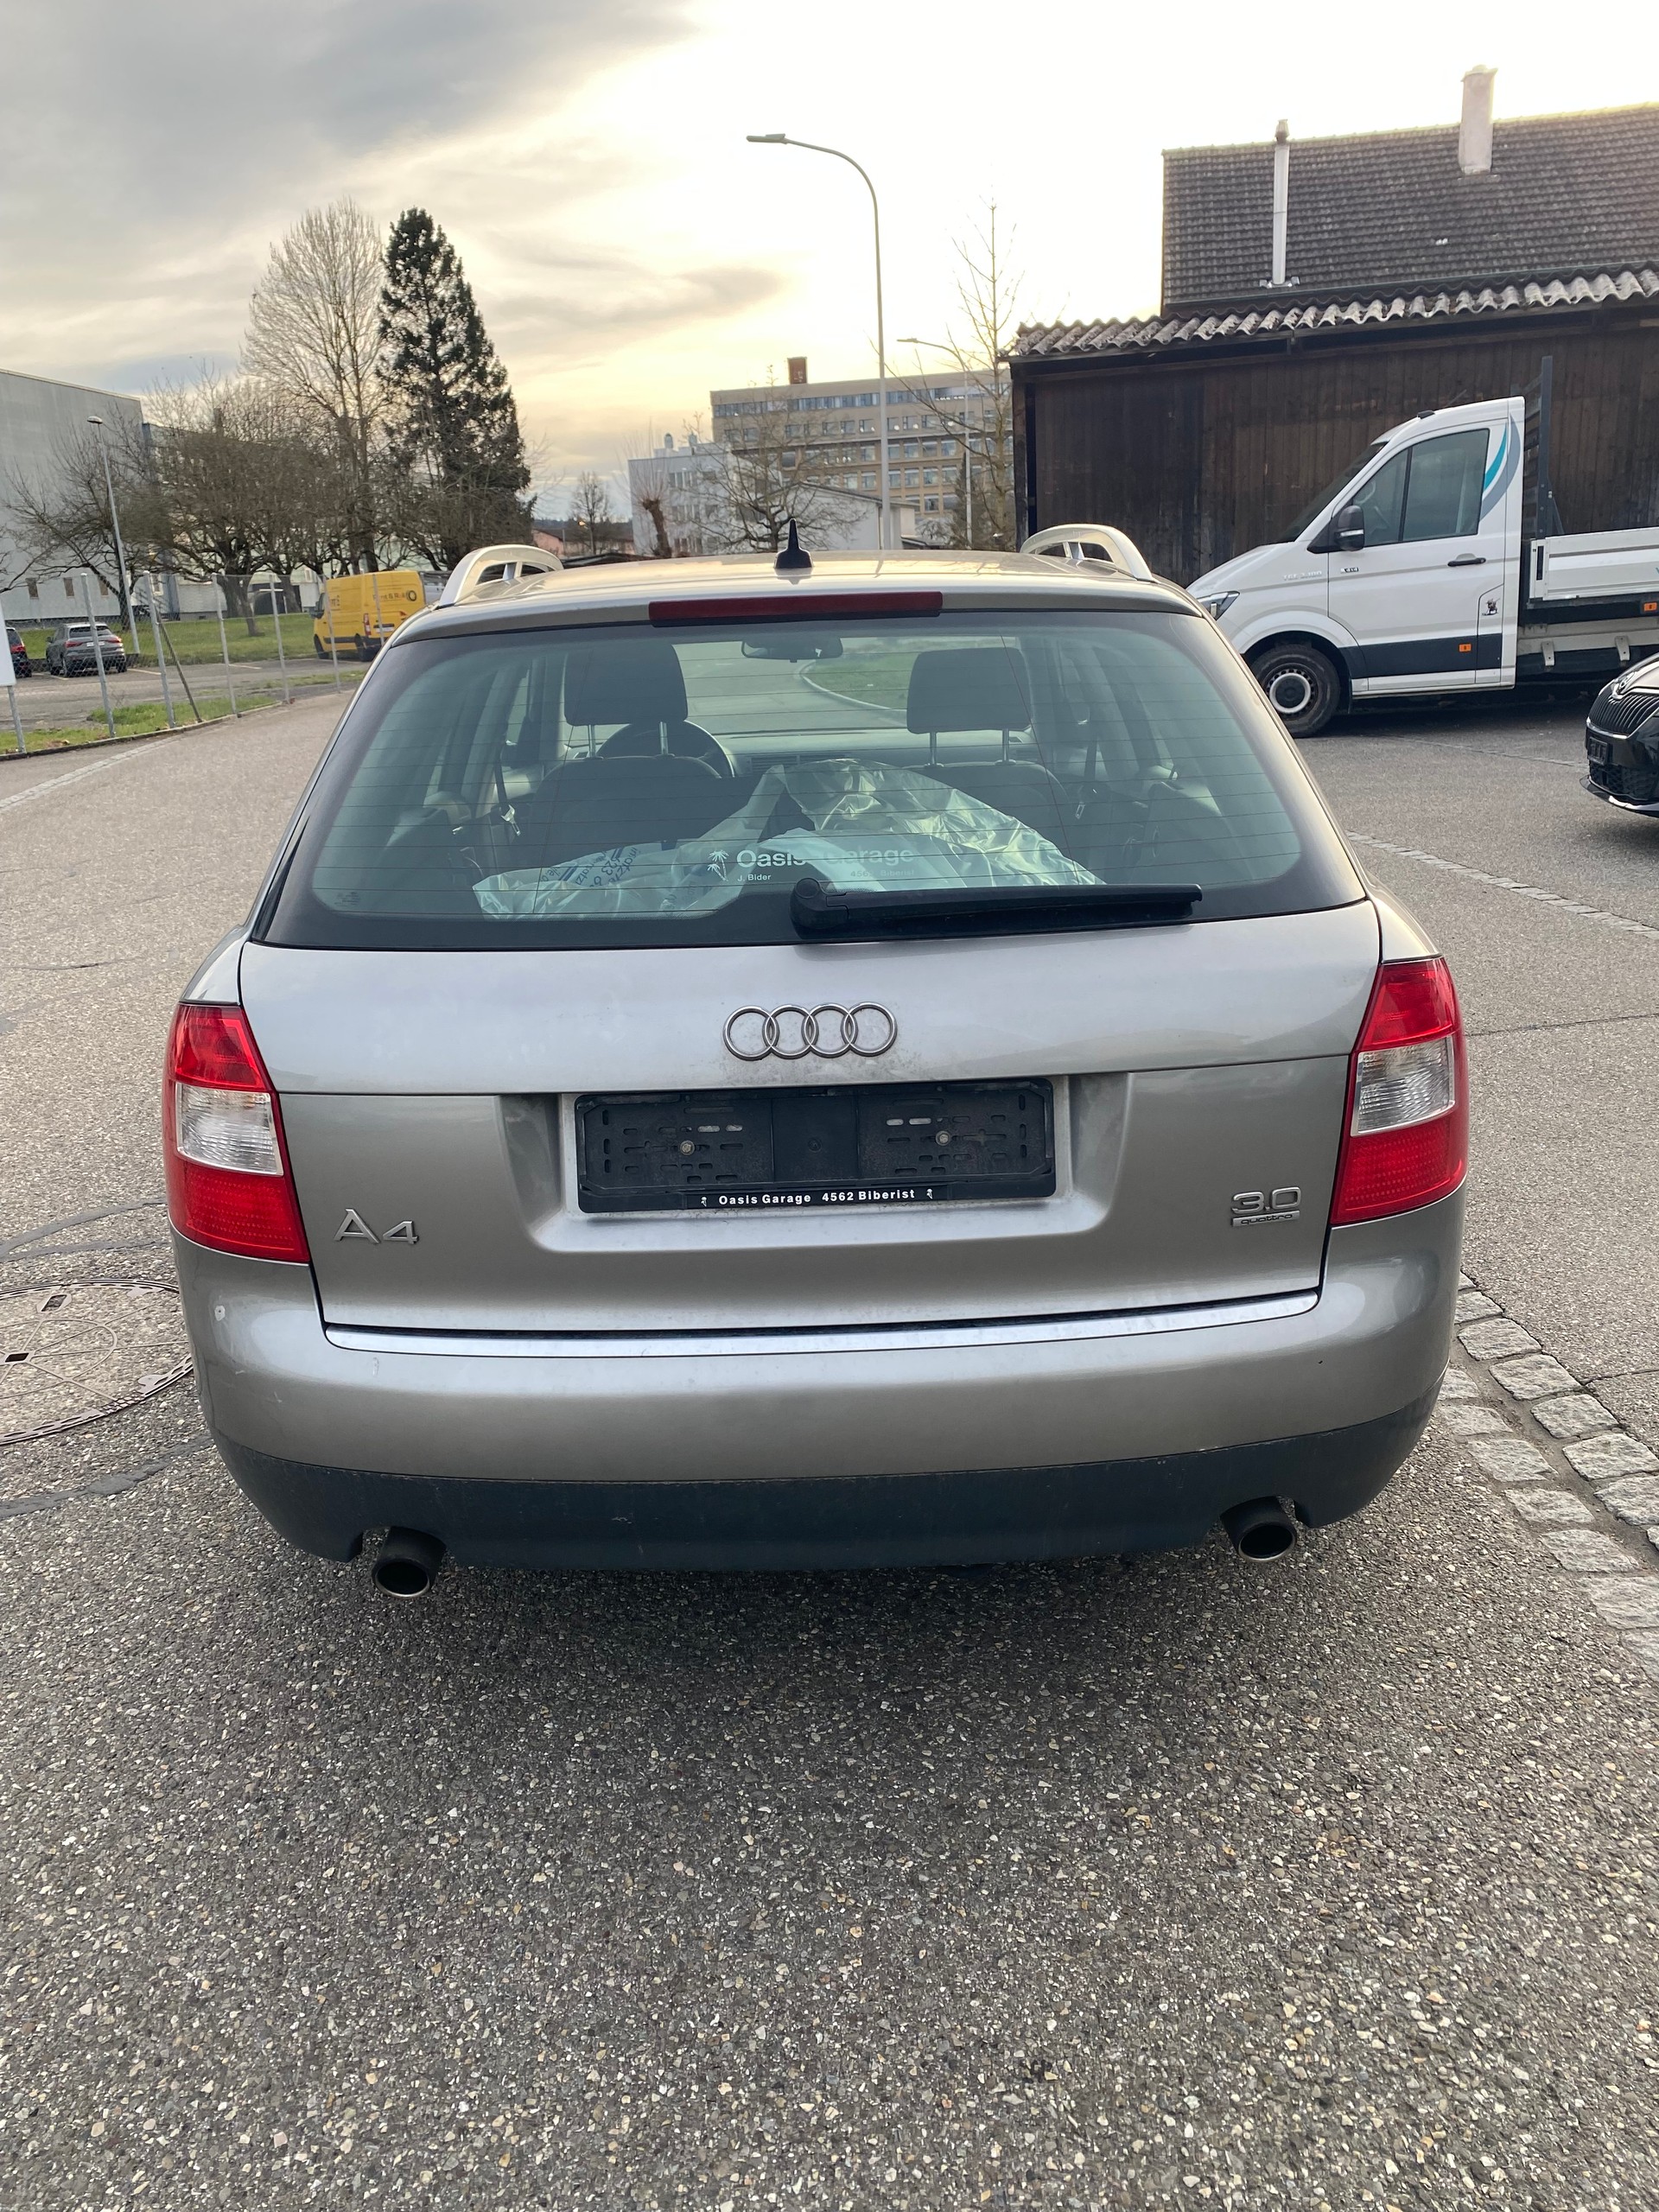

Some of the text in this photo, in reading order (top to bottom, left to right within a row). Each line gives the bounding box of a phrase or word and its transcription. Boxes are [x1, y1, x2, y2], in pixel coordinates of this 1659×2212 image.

[718, 1188, 915, 1205] Oasis Garage 4562 Biberist
[1231, 1186, 1301, 1214] 3.0
[334, 1208, 420, 1244] A4
[1240, 1213, 1294, 1224] quattro
